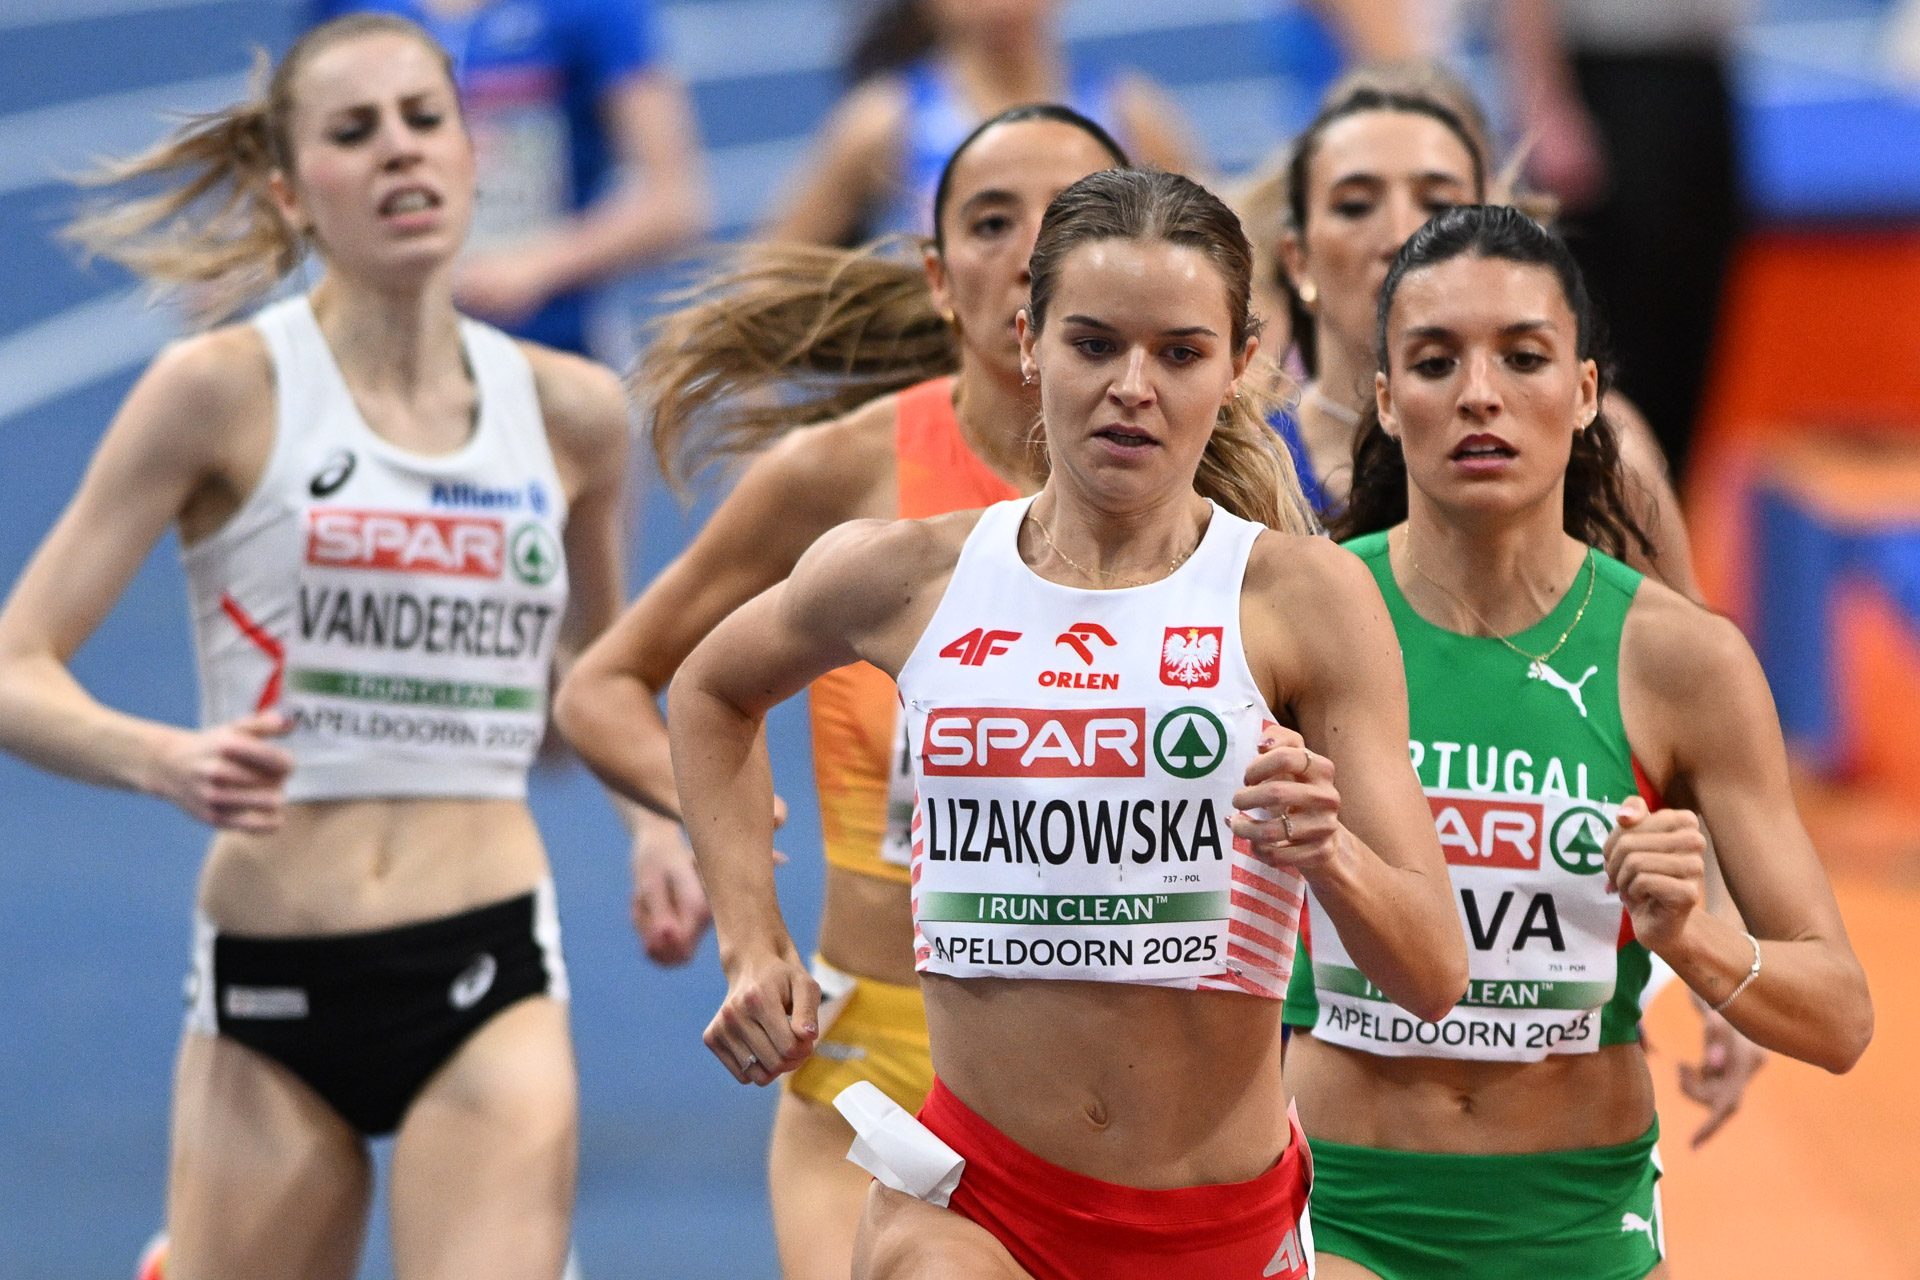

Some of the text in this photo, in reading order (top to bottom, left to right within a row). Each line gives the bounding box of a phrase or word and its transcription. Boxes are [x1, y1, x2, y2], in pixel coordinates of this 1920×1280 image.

[314, 515, 501, 572] SPAR
[299, 585, 553, 659] VANDERELST
[939, 628, 1023, 666] 4F
[1038, 671, 1120, 690] ORLEN
[929, 717, 1139, 768] SPAR
[928, 797, 1224, 866] LIZAKOWSKA
[1434, 806, 1537, 861] AR
[1163, 875, 1178, 883] 737
[1185, 874, 1201, 882] POL
[978, 896, 985, 919] I
[991, 897, 1049, 920] RUN
[1460, 888, 1566, 952] VA
[934, 935, 1218, 966] APELDOORN 2025
[1549, 964, 1563, 972] 753
[1569, 964, 1586, 972] POR
[1326, 1004, 1591, 1048] APELDOORN 2025
[1263, 1228, 1304, 1278] 4
